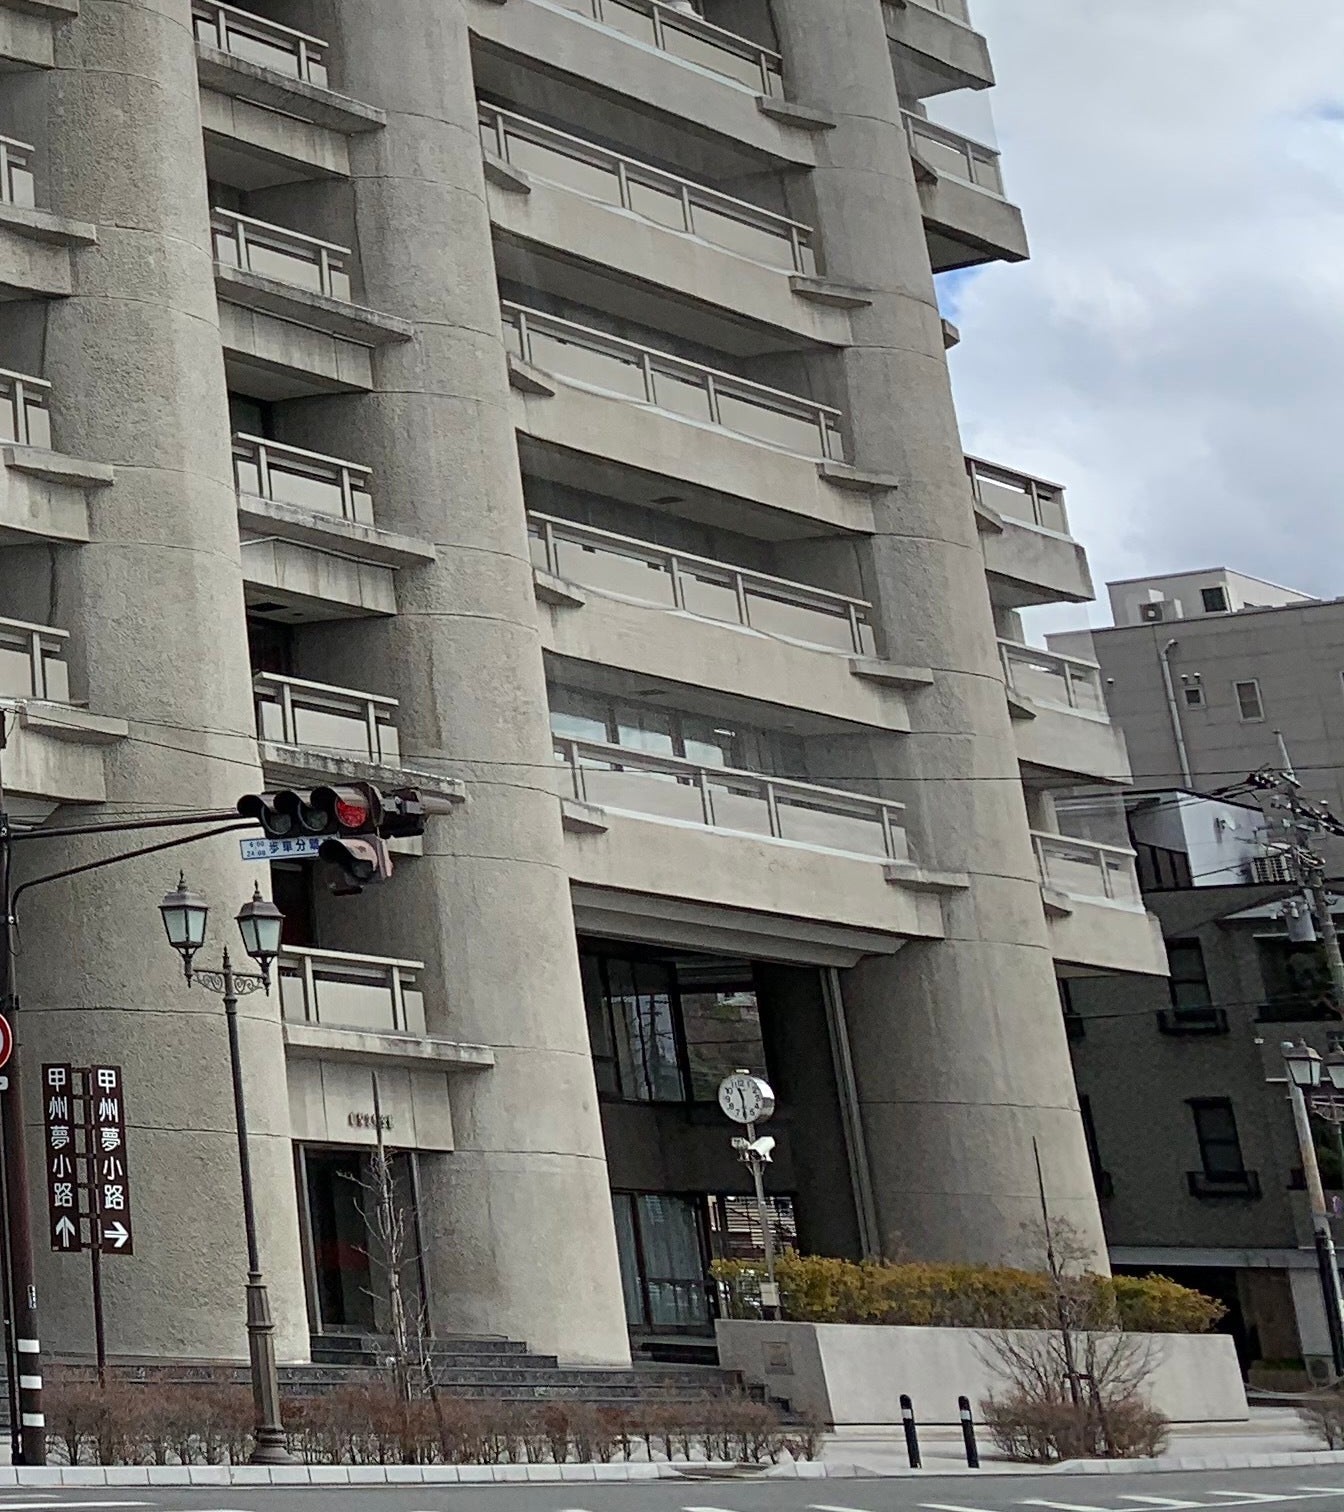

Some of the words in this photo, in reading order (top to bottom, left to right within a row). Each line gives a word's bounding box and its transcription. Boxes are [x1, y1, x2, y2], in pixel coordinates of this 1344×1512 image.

[269, 839, 319, 854] 歩車分離
[48, 1068, 73, 1207] 甲州夢小路
[98, 1069, 124, 1210] 甲州夢小路
